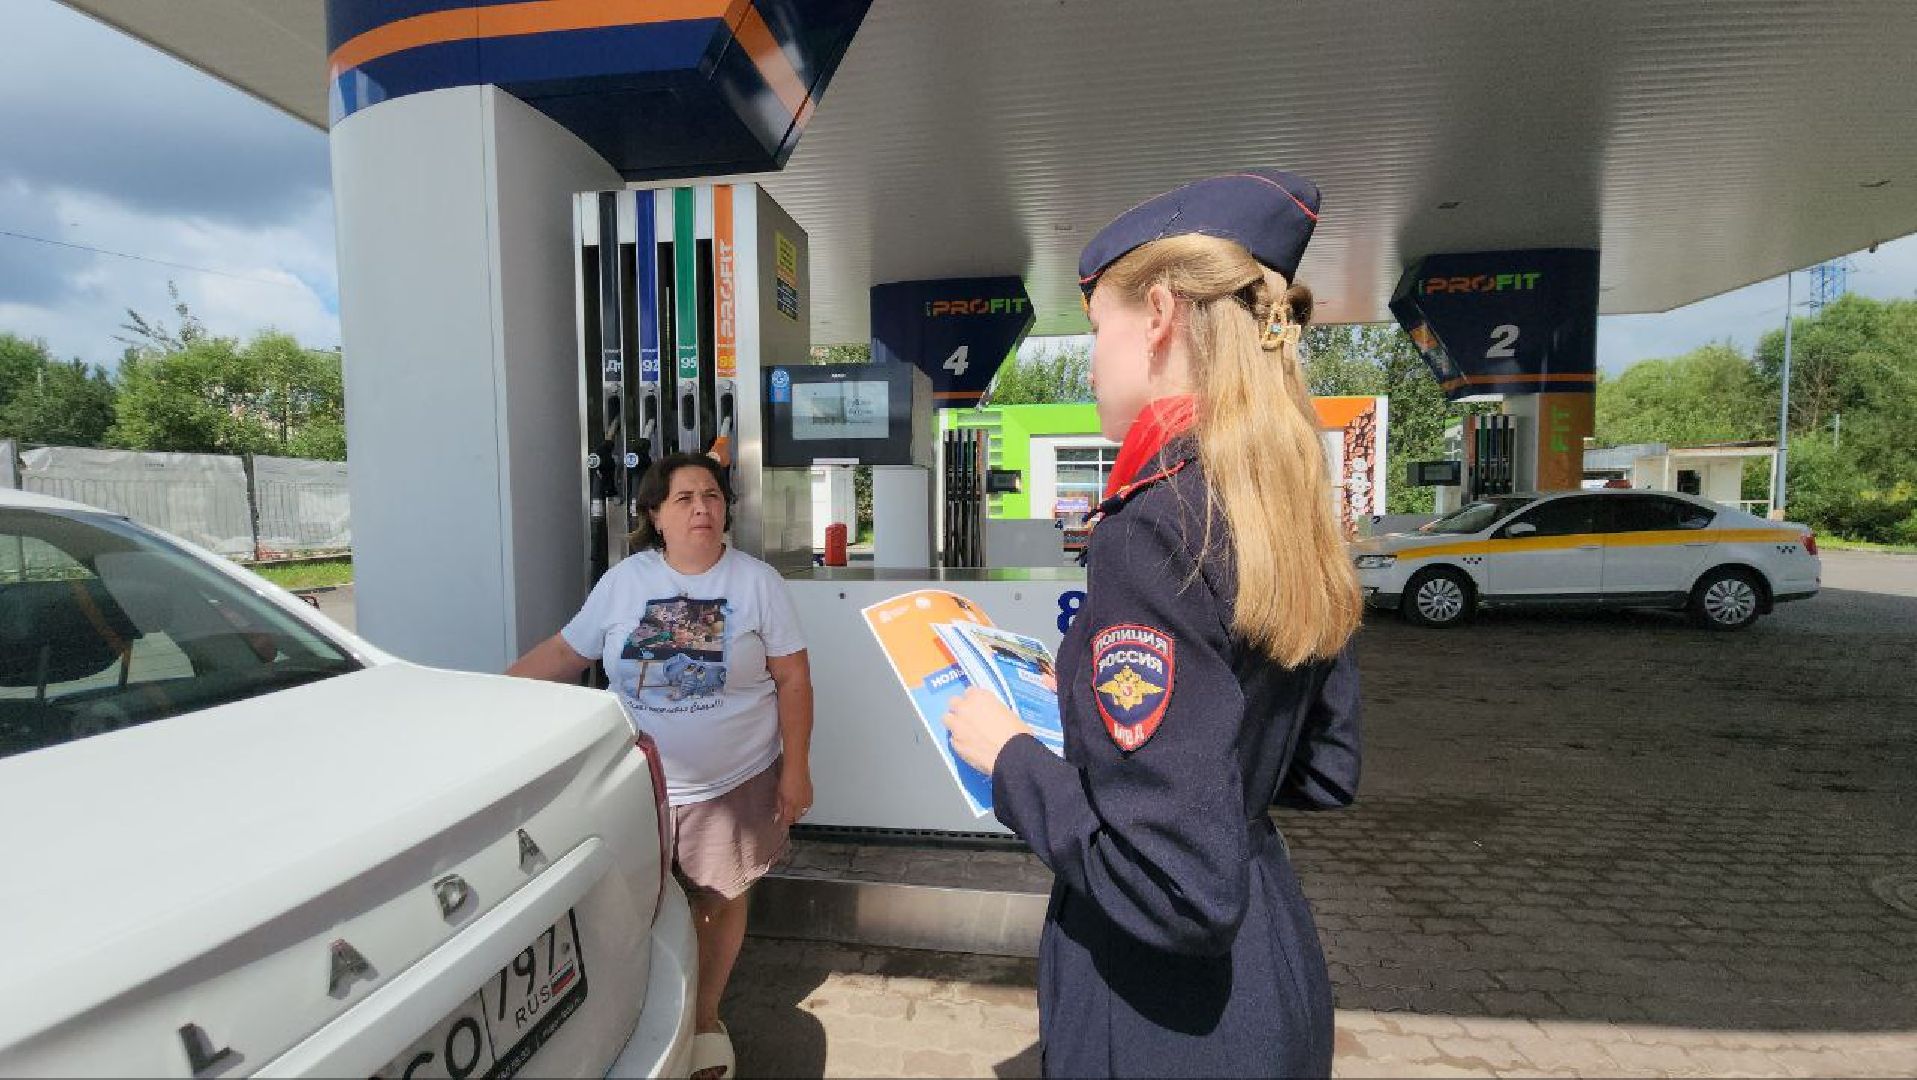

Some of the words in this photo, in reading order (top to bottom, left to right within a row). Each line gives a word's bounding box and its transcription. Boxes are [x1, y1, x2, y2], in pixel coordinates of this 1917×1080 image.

[1487, 324, 1520, 359] 2
[680, 355, 697, 369] 95
[943, 346, 969, 376] 4
[1055, 519, 1064, 531] 4
[1095, 629, 1168, 655] ПОЛИЦИЯ
[1099, 650, 1163, 674] РОССИЯ
[1114, 722, 1145, 746] МВД
[177, 828, 548, 1079] LADA
[515, 985, 550, 1030] RUS
